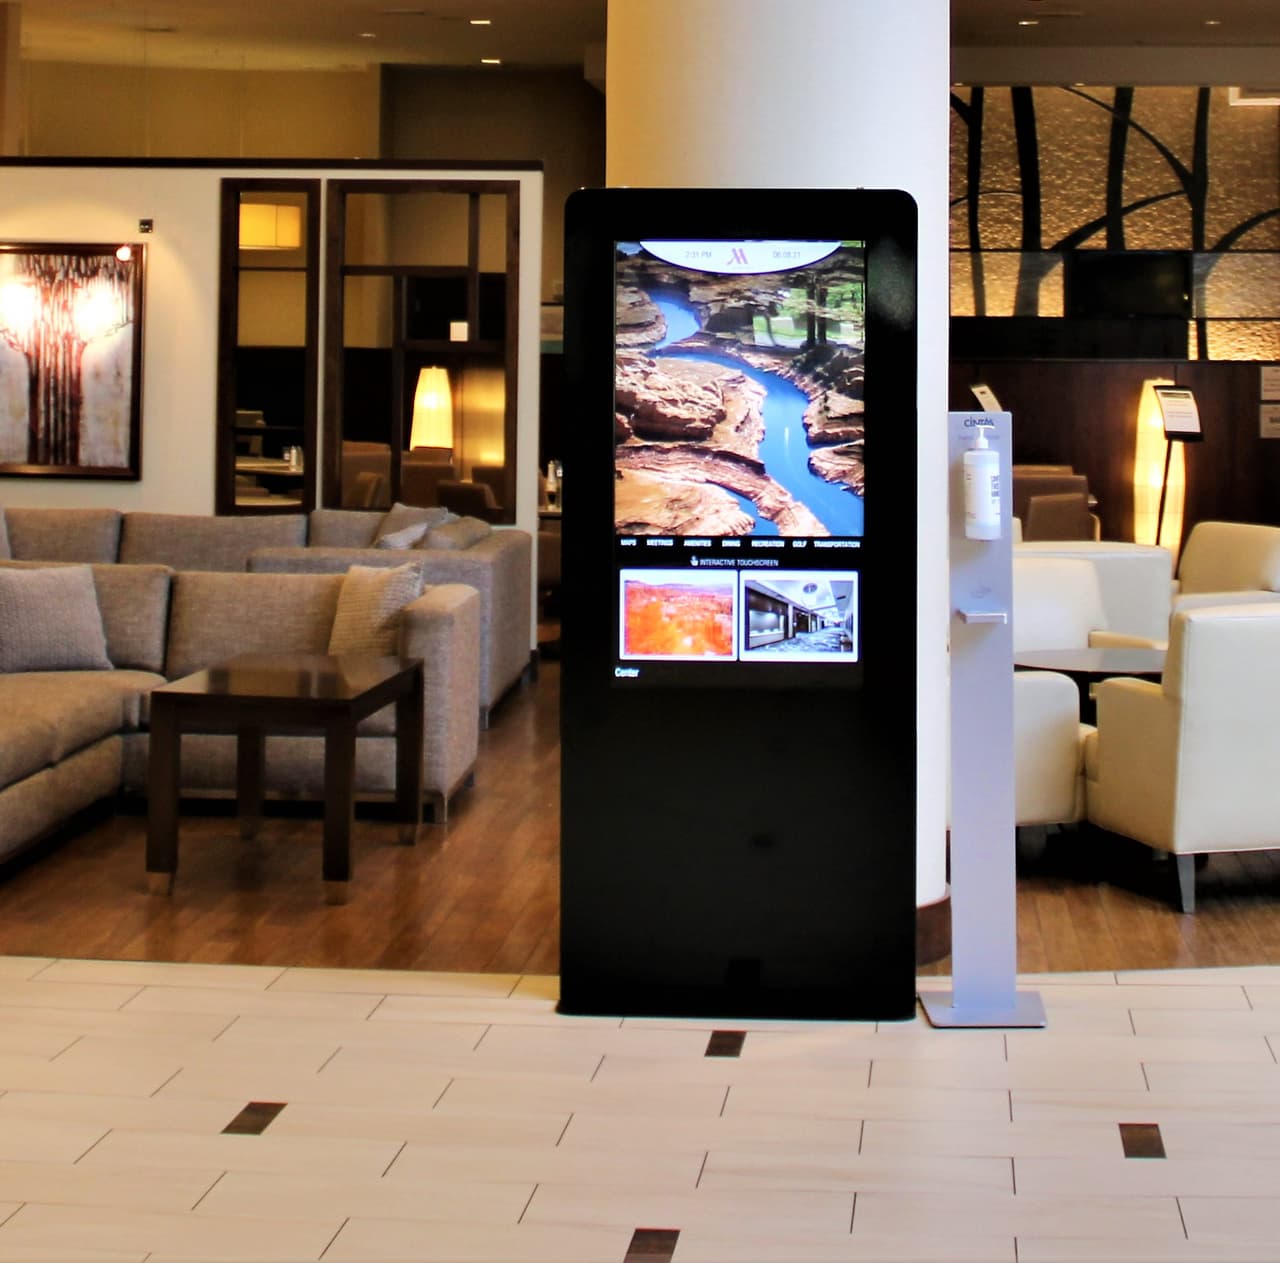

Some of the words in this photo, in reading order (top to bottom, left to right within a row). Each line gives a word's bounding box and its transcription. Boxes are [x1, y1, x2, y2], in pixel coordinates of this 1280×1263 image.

[813, 540, 861, 548] TRANSPORTATION
[699, 558, 735, 567] INTERACTIVE
[737, 559, 779, 567] TOUCHSCREEN
[615, 667, 640, 677] Center
